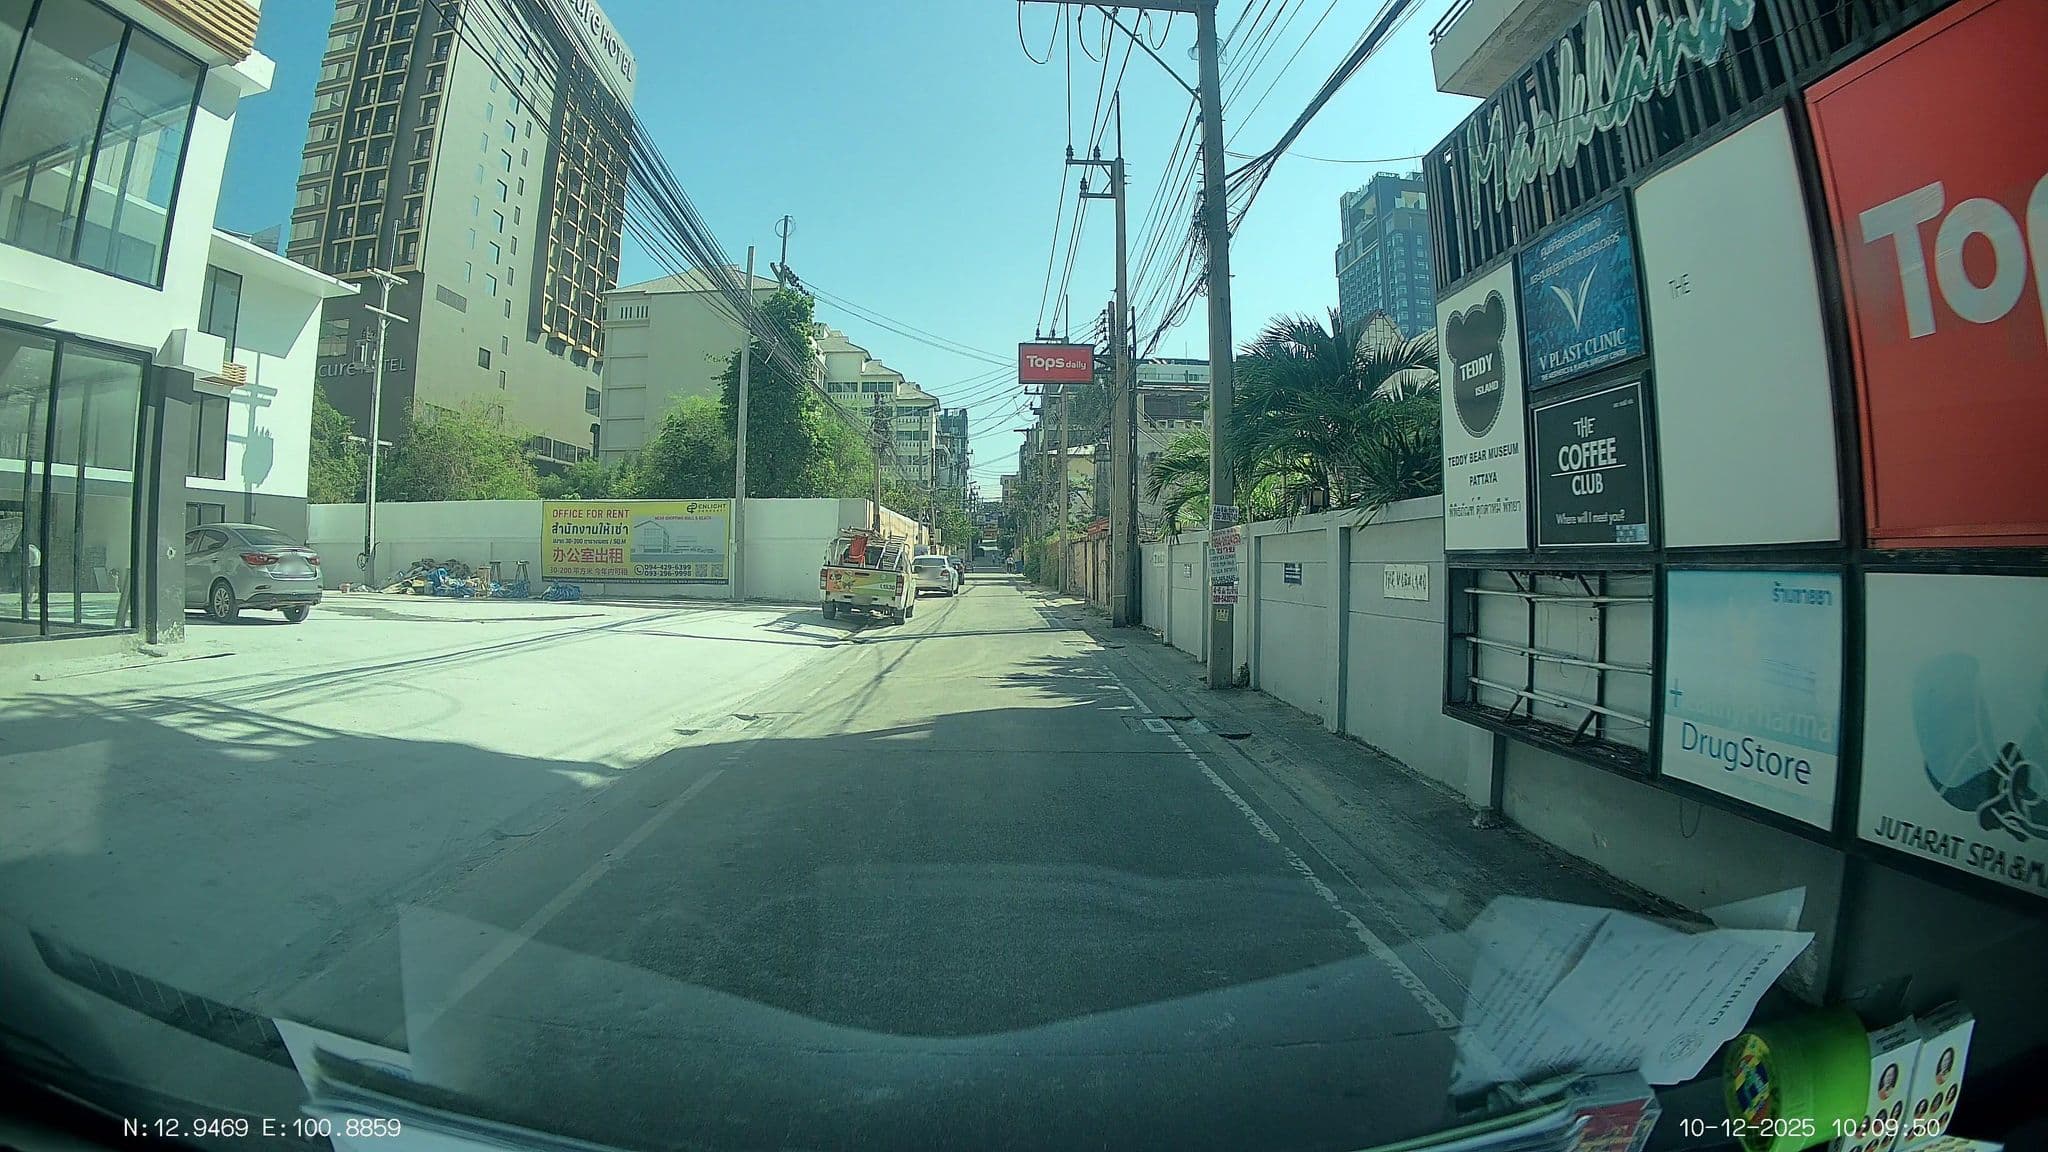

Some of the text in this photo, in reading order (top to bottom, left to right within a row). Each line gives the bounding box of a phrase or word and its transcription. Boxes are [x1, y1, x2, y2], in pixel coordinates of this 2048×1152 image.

[571, 0, 632, 82] ure HOTEL
[1859, 172, 2048, 352] To
[1668, 273, 1692, 299] THE
[1540, 328, 1625, 371] V PLAST CLINIC
[319, 357, 406, 377] cure TEL
[1026, 355, 1087, 371] Tops daily
[1460, 353, 1493, 381] TEDDY
[1475, 380, 1499, 396] ISLAND
[1573, 416, 1596, 438] THE
[1448, 442, 1519, 467] TEDDY BEAR MUSEUM
[1559, 437, 1617, 471] COFFEE
[1469, 472, 1498, 487] PATTAYA
[1572, 473, 1604, 495] CLUB
[552, 509, 630, 518] OFFICE FOR RENT
[552, 522, 629, 535] สำนักงานให้เช่า
[553, 547, 624, 563] 办公室出租
[1682, 721, 1811, 785] DrugStore
[1874, 815, 1965, 860] JUTARAT
